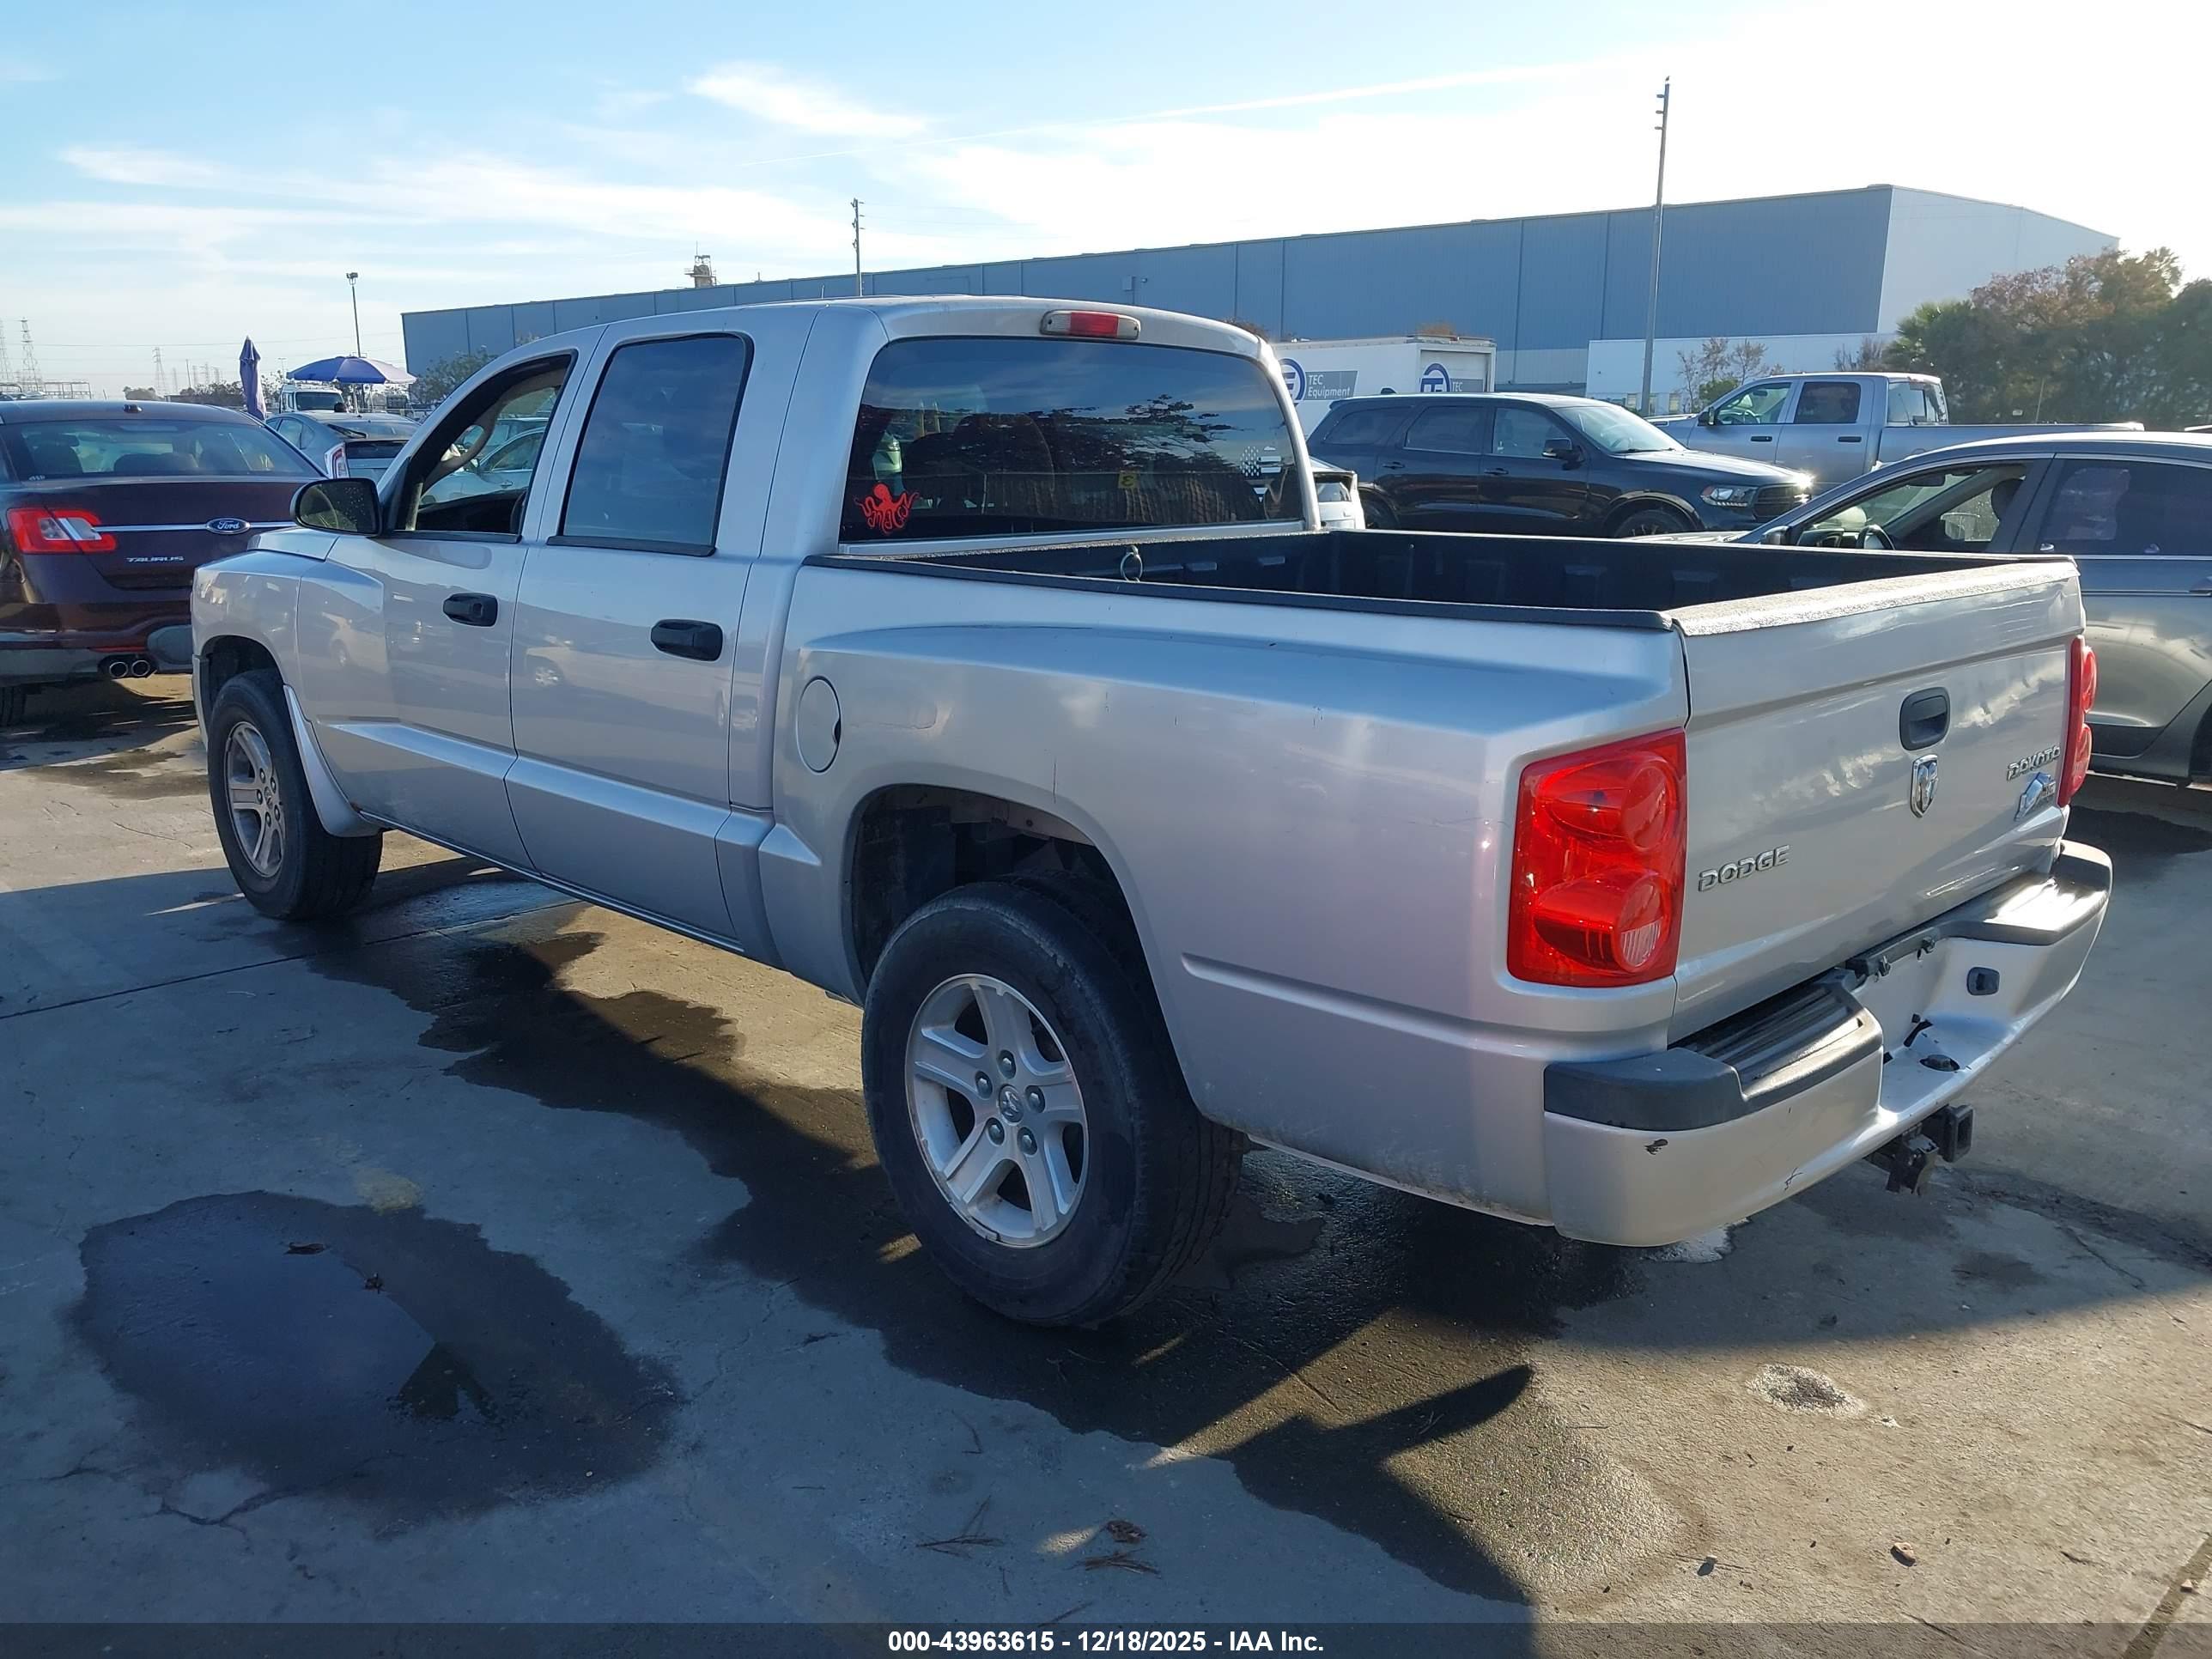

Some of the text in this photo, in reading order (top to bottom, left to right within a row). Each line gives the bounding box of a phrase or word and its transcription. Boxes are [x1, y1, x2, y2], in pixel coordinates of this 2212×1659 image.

[1308, 374, 1324, 386] TEC
[1308, 386, 1351, 399] Equipment
[216, 520, 240, 531] Ford
[2006, 744, 2061, 782] DAKOTA
[1698, 844, 1790, 892] DODGE
